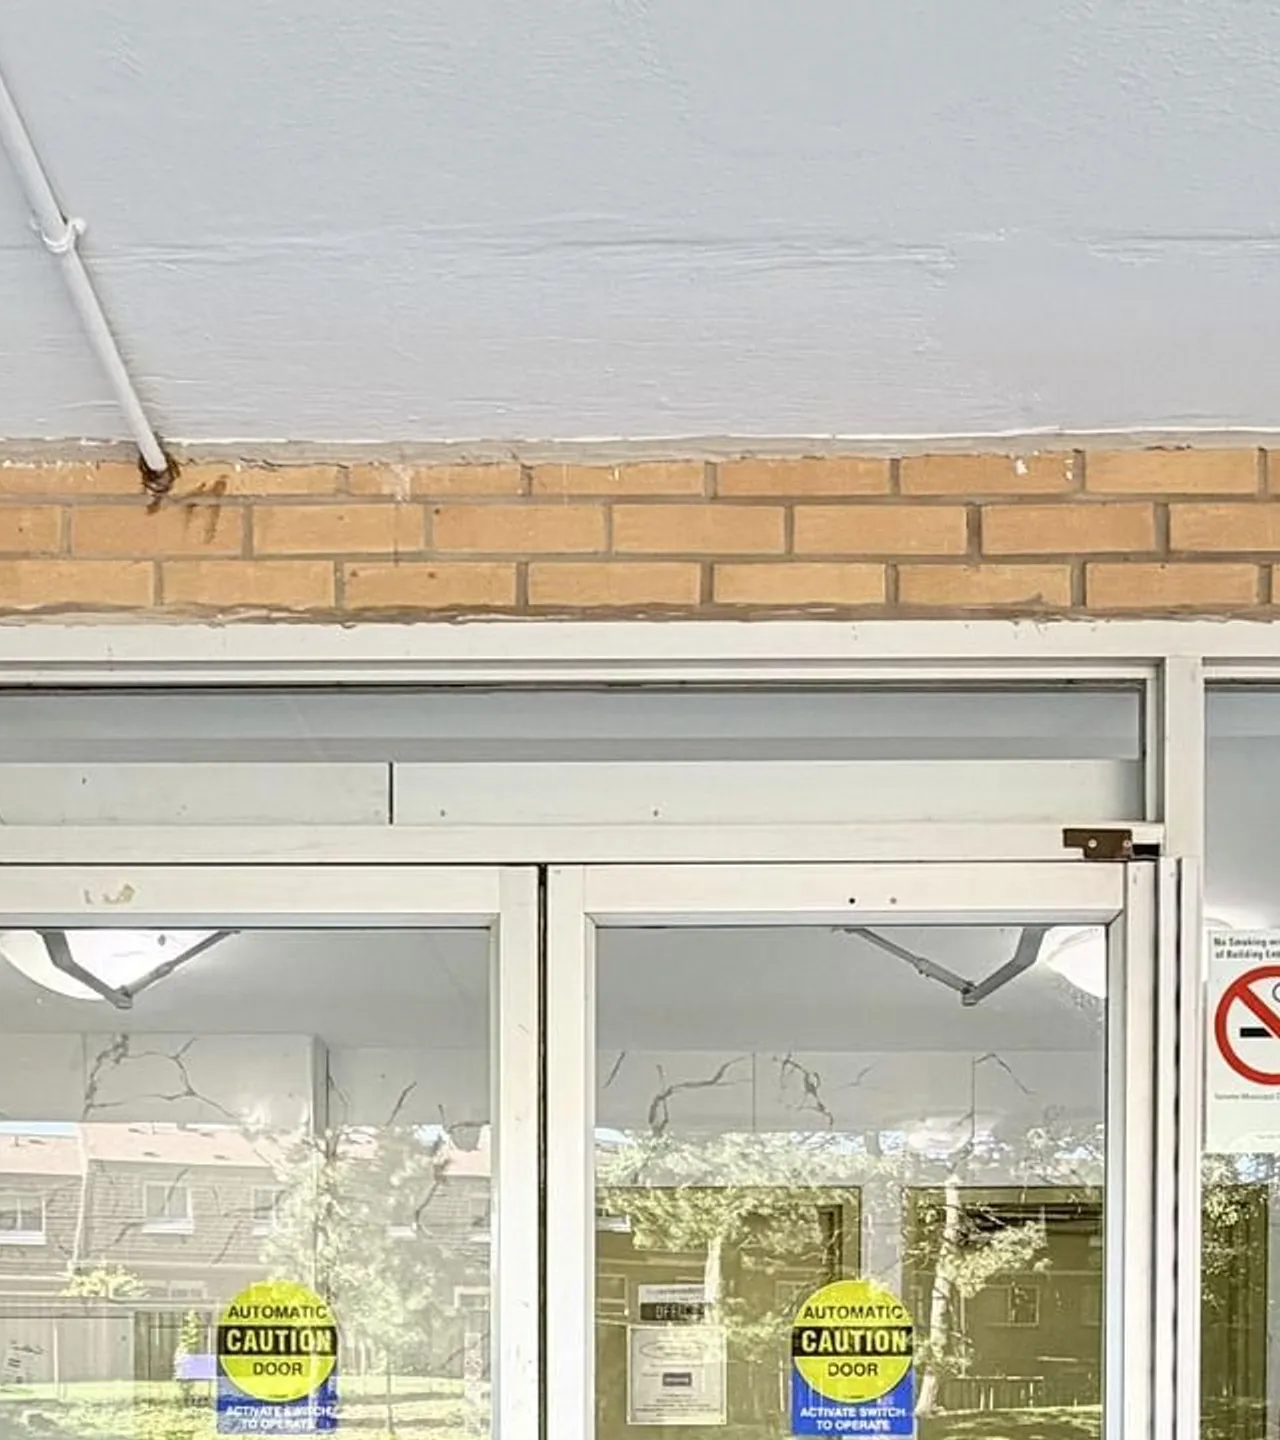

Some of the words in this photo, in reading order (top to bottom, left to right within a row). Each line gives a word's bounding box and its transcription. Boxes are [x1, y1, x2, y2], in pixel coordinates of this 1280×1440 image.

[228, 1304, 327, 1319] AUTOMATIC
[804, 1304, 903, 1320] AUTOMATIC
[226, 1328, 332, 1352] CAUTION
[801, 1329, 906, 1353] CAUTION
[253, 1361, 303, 1376] DOOR
[828, 1362, 878, 1377] DOOR
[225, 1406, 281, 1416] ACTIVATE
[800, 1407, 857, 1417] ACTIVATE
[859, 1407, 906, 1417] SWITCH
[241, 1419, 258, 1429] TO
[816, 1420, 832, 1431] TO
[835, 1420, 891, 1431] OPERATE
